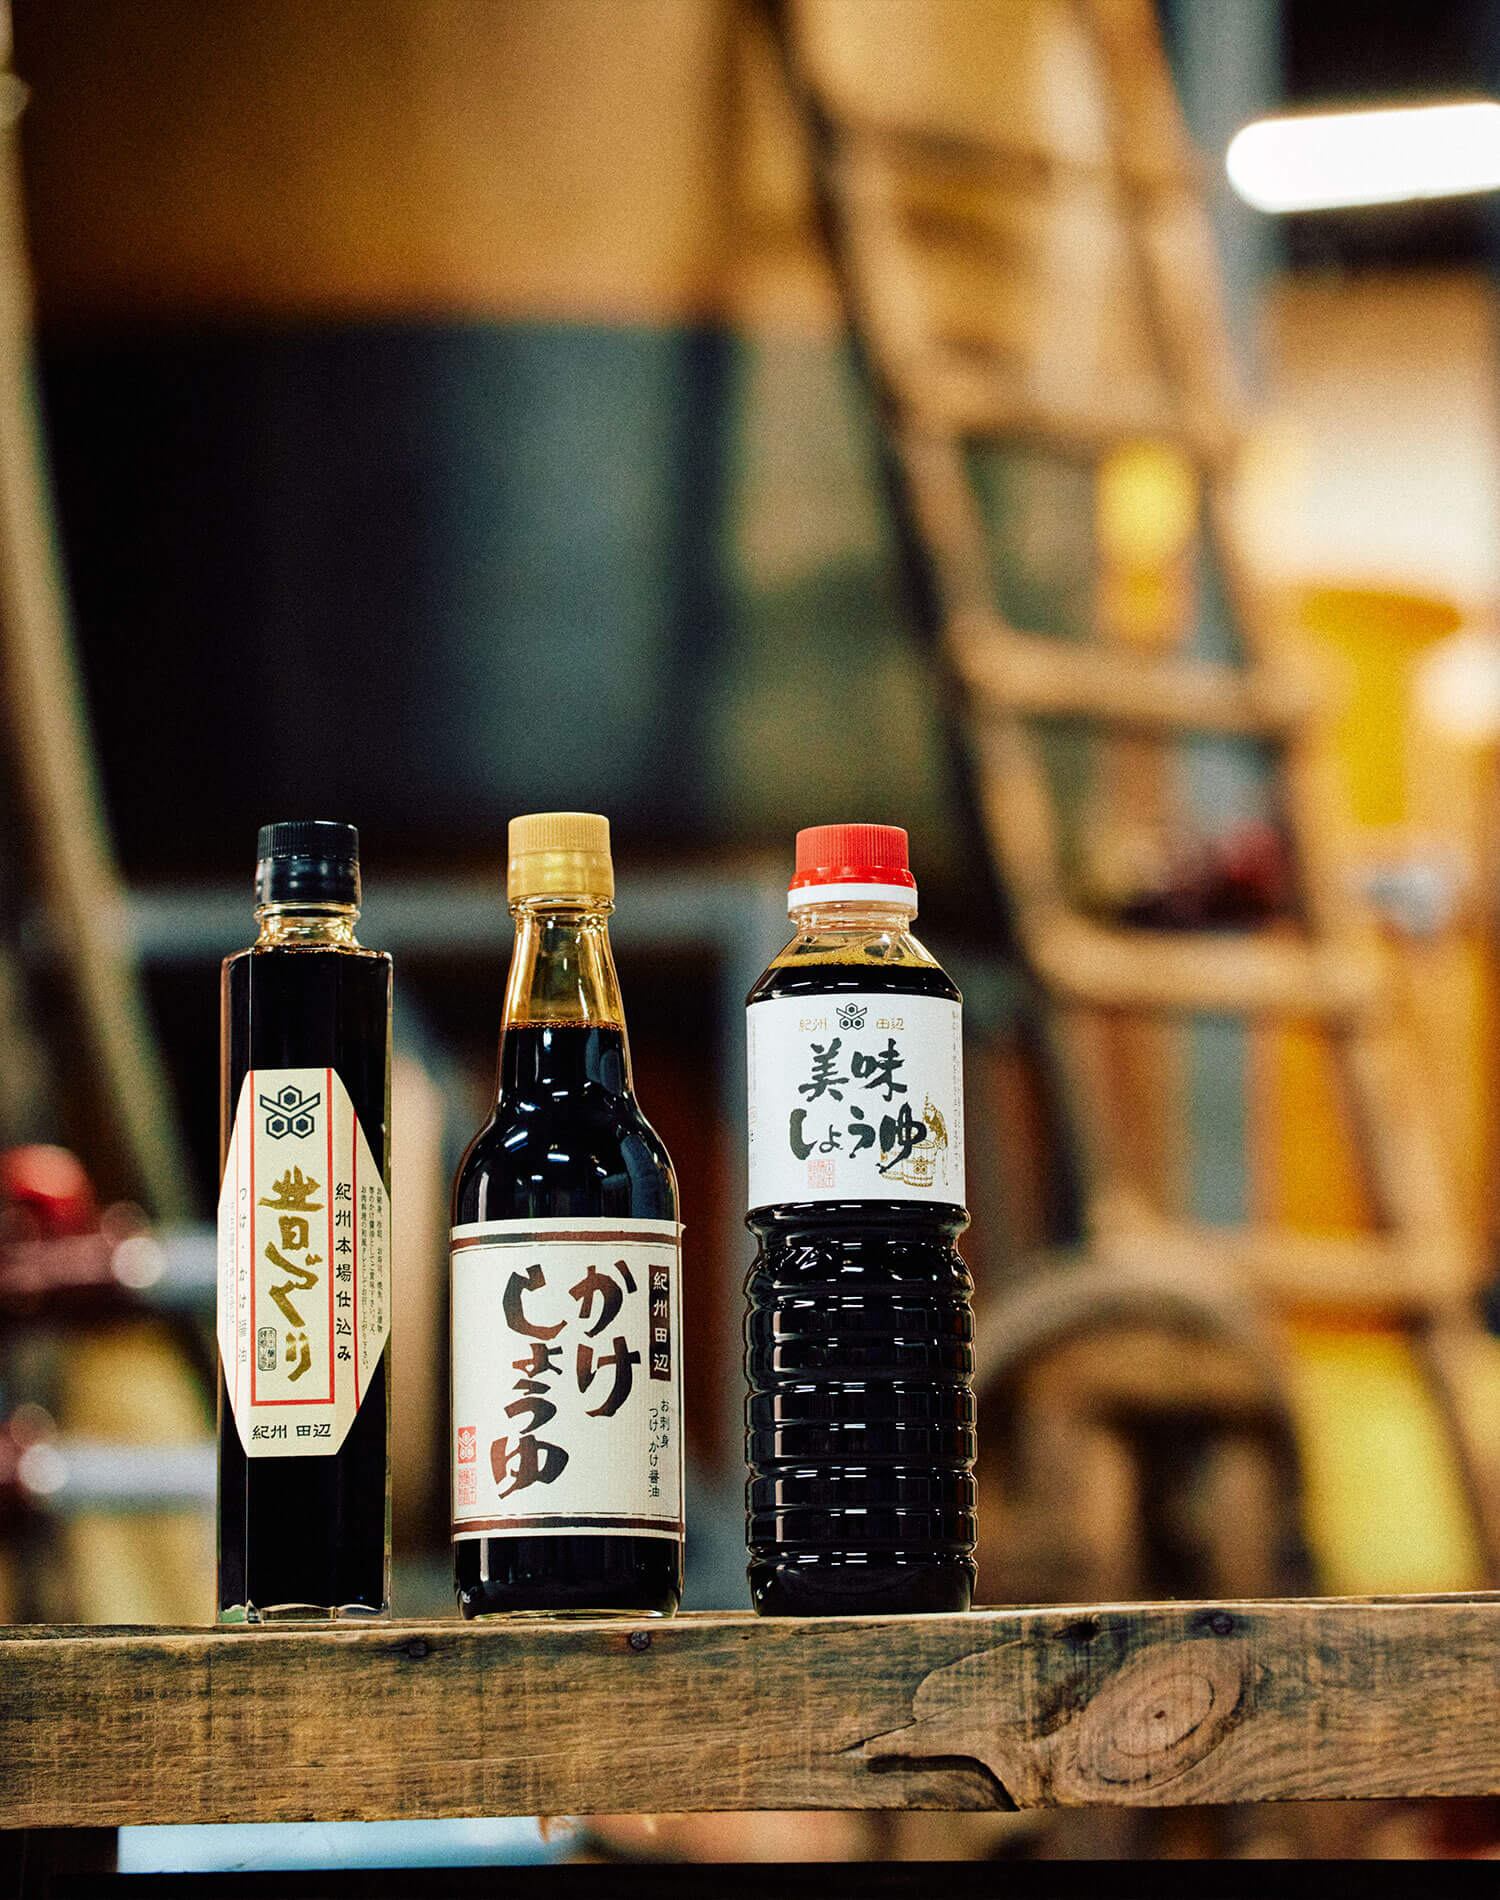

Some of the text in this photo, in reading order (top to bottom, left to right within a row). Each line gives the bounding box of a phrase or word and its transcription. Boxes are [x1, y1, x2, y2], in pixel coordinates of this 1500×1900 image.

[799, 1017, 905, 1031] 紀州 田辺
[798, 1037, 907, 1102] 美味
[789, 1102, 927, 1174] しょうゆ
[257, 1164, 325, 1382] 昔づくり
[335, 1182, 352, 1362] 紀州本場仕込み
[568, 1259, 641, 1418] かけ
[652, 1272, 669, 1373] 紀州田辺
[490, 1263, 569, 1500] しょうゆ
[660, 1399, 670, 1448] お刺身
[252, 1423, 332, 1440] 紀州 田辺
